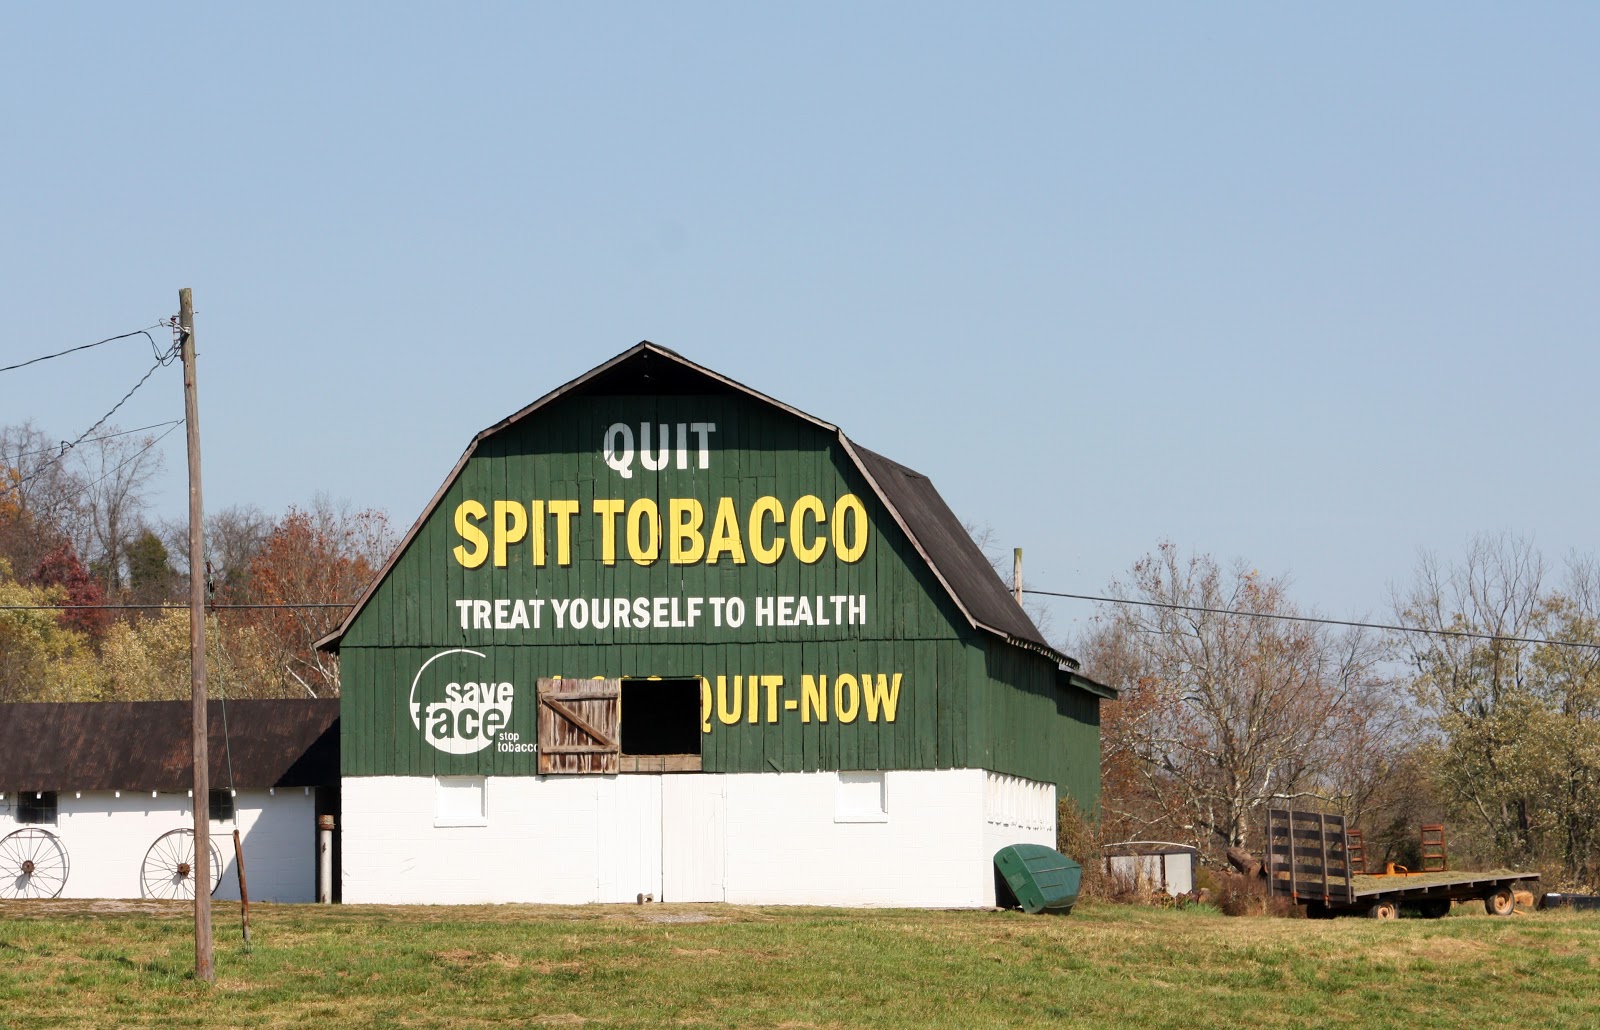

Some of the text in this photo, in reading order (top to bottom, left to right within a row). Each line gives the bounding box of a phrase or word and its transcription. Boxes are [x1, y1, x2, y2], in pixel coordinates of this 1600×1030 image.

[603, 422, 716, 479] QUIT
[453, 494, 869, 568] SPIT TOBACCO
[456, 595, 866, 629] TREAT YOURSELF TO HEALTH
[445, 682, 514, 704] save
[416, 702, 505, 741] face
[499, 731, 519, 742] stop
